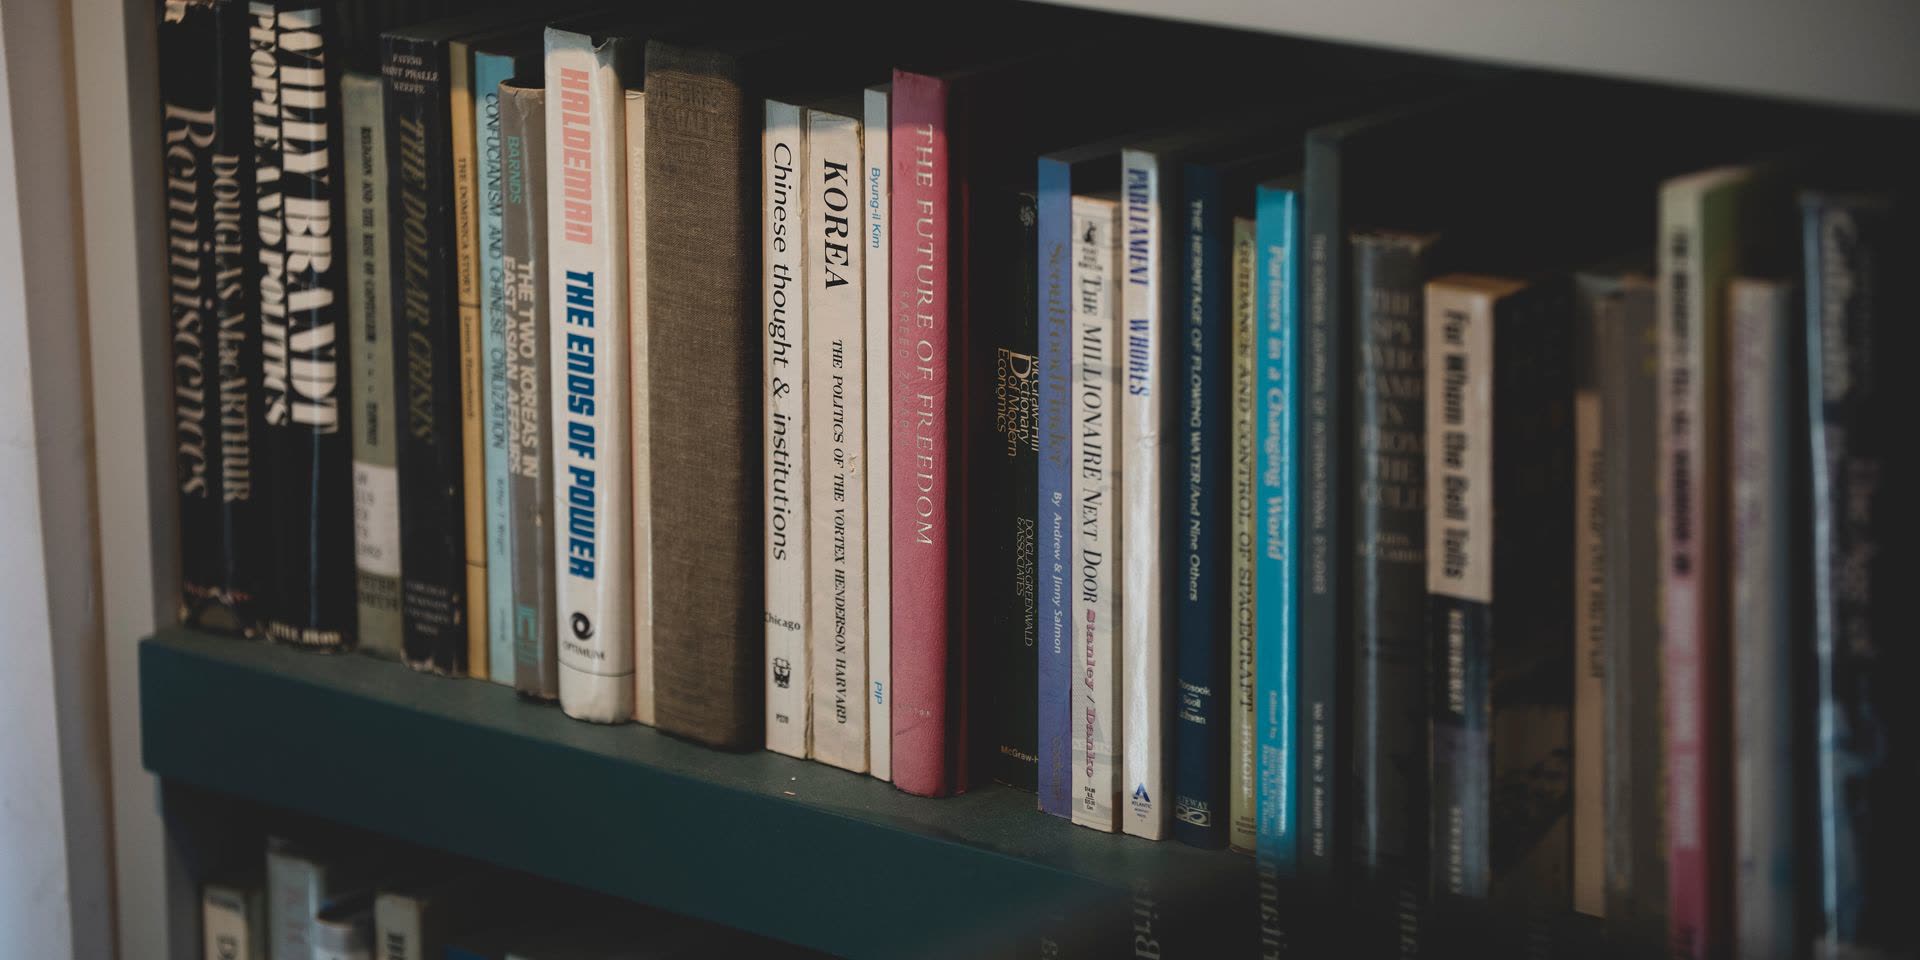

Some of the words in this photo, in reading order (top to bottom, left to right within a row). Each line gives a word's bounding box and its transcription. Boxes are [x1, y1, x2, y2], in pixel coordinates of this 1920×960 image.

[249, 1, 281, 150] PEOPLE
[277, 8, 330, 184] WILLY
[485, 92, 503, 217] CONFUCIANISM
[507, 135, 522, 205] BARNDS
[561, 67, 592, 245] HALDEMAN
[916, 124, 933, 188] THE
[211, 153, 244, 300] DOUGLAS
[255, 155, 283, 246] AND
[773, 142, 793, 253] Chinese
[823, 157, 849, 291] KOREA
[868, 167, 880, 221] Byung-il
[1127, 168, 1149, 286] PARLIAMENT
[1190, 199, 1203, 231] THE
[401, 188, 430, 326] DOLLAR
[488, 225, 503, 260] AND
[871, 223, 881, 249] Kim
[915, 198, 934, 330] FUTURE
[165, 103, 216, 499] Reminiscences
[463, 254, 472, 296] STORY
[488, 267, 503, 337] CHINESE
[503, 255, 518, 311] EAST
[517, 258, 536, 306] THE
[566, 270, 594, 328] THE
[1239, 239, 1251, 358] GUIDANCE
[1268, 245, 1285, 333] Partners
[259, 249, 287, 426] POLITICS
[284, 197, 338, 433] BRANDT
[505, 314, 520, 382] ASIAN
[517, 309, 538, 359] TWO
[768, 262, 793, 369] thought
[1190, 328, 1202, 351] OF
[1268, 338, 1283, 360] in
[1446, 310, 1466, 341] For
[407, 330, 434, 442] CRISIS
[567, 332, 595, 417] ENDS
[772, 376, 791, 398] &
[832, 339, 843, 370] THE
[915, 339, 934, 381] OF
[1008, 375, 1020, 395] of
[1128, 318, 1150, 397] WHORES
[1239, 363, 1251, 412] AND
[1268, 366, 1282, 381] a
[216, 307, 250, 503] MacARTHUR
[491, 347, 507, 451] CIVILIZATION
[519, 362, 540, 449] KOREAS
[832, 375, 844, 444] POLITICS
[997, 347, 1010, 433] Economics
[1008, 351, 1032, 445] Dictionary
[1081, 321, 1102, 481] MILLIONAIRE
[1190, 355, 1202, 427] FLOWING
[1445, 355, 1466, 425] Whom
[506, 387, 522, 475] AFFAIRS
[568, 419, 595, 461] OF
[833, 448, 845, 470] OF
[1008, 395, 1020, 458] Modern
[1264, 387, 1285, 488] Changing
[1445, 432, 1466, 468] the
[522, 454, 539, 478] IN
[772, 412, 792, 561] institutions
[833, 473, 845, 503] THE
[914, 393, 935, 546] FREEDOM
[1051, 491, 1063, 508] By
[1239, 420, 1252, 525] CONTROL
[1446, 475, 1467, 520] Bell
[568, 464, 595, 580] POWER
[834, 507, 846, 565] VORTEX
[1024, 518, 1034, 575] DOUGLAS
[1053, 512, 1064, 560] Andrew
[1082, 487, 1103, 543] NEXT
[1190, 520, 1201, 550] Nine
[1239, 531, 1251, 561] OF
[1268, 496, 1285, 561] World
[1053, 562, 1064, 574] &
[1083, 547, 1103, 604] DOOR
[1189, 553, 1201, 601] Others
[1446, 528, 1467, 579] Tolls
[834, 568, 846, 652] HENDERSON
[1024, 575, 1034, 647] GREENWALD
[1051, 575, 1064, 608] Jinny
[1053, 608, 1064, 654] Salmon
[1085, 609, 1097, 692] Stanley
[1239, 567, 1253, 712] SPACECRAFT
[1447, 609, 1465, 717] HEMINGWAY
[835, 658, 847, 725] HARVARD
[873, 681, 883, 705] PIP
[1085, 705, 1097, 778] Danko
[1312, 786, 1324, 830] Autumn
